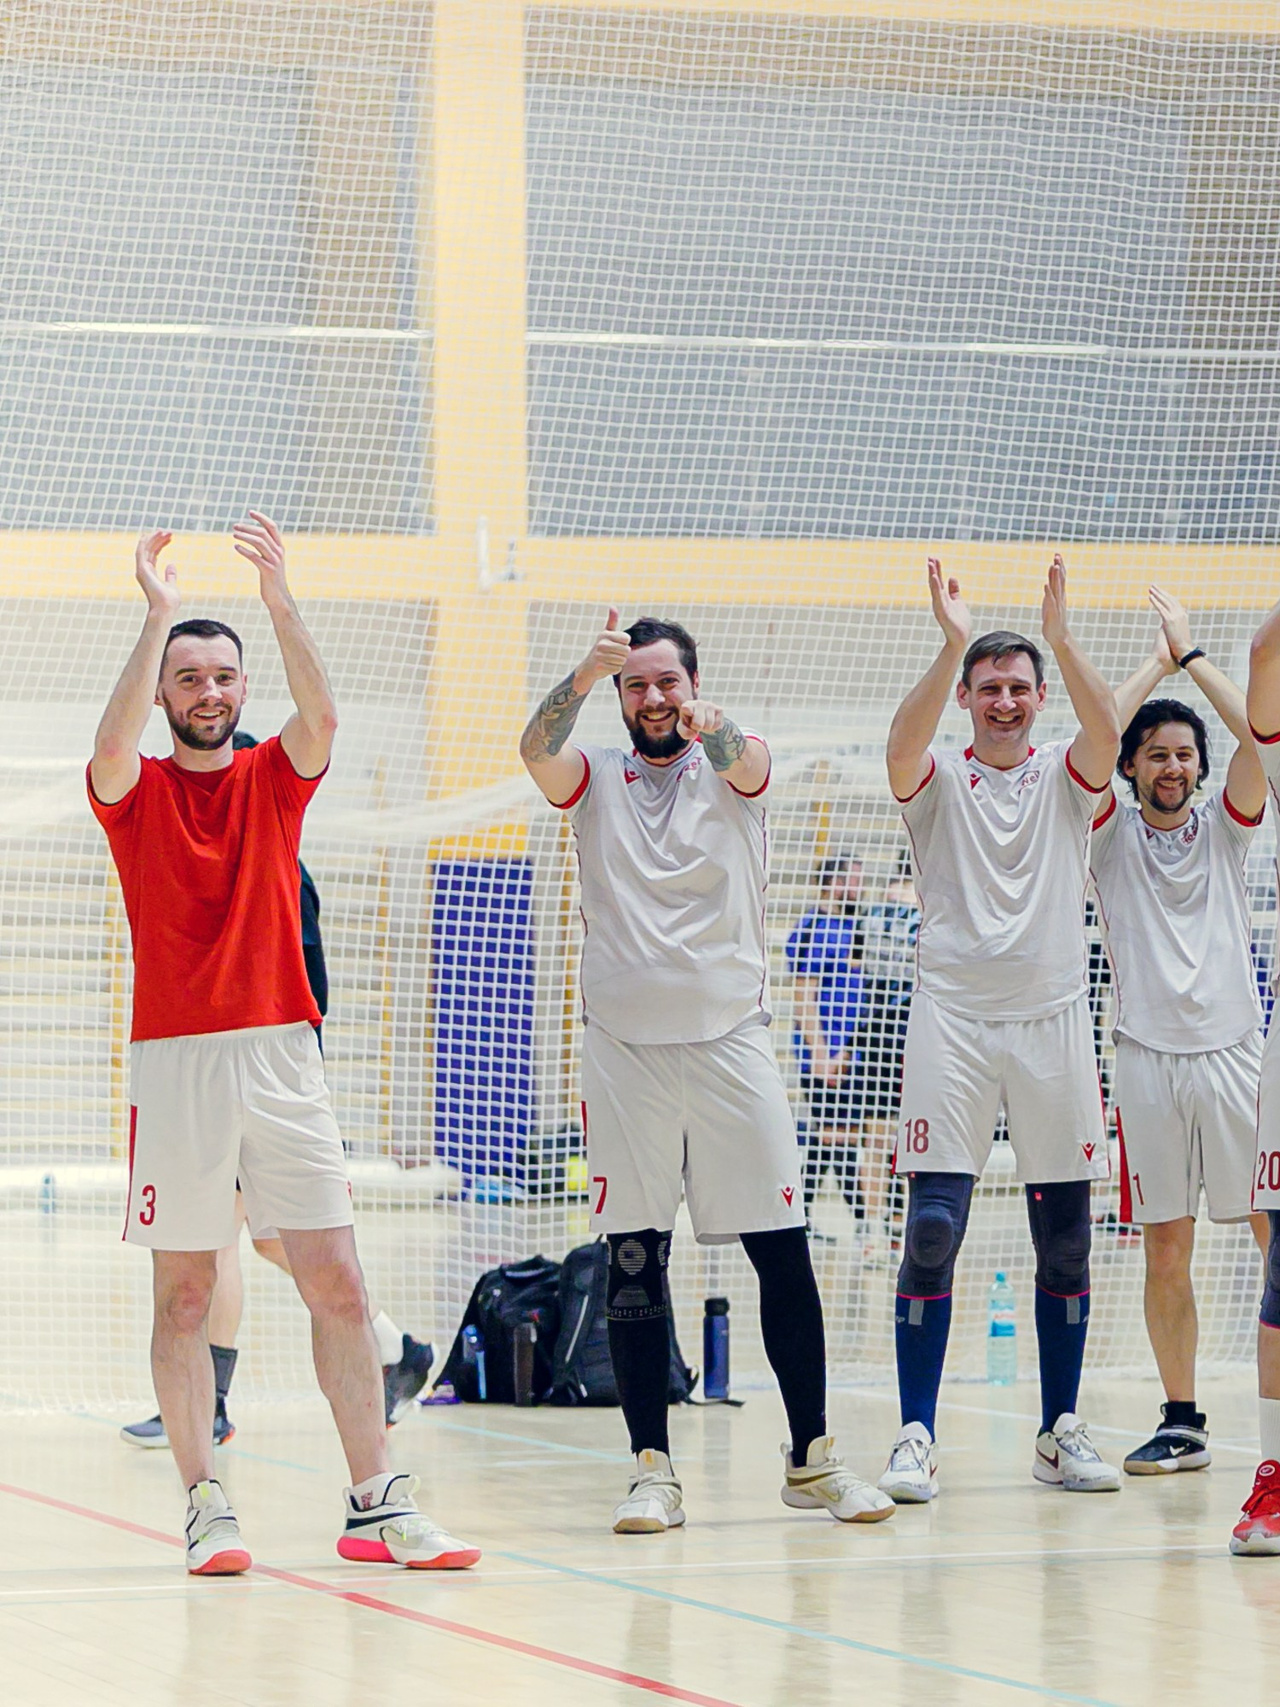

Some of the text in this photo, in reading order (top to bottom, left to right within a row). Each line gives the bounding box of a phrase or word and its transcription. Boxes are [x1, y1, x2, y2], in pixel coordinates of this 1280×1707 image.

[904, 1117, 929, 1154] 18
[138, 1183, 157, 1227] 3
[592, 1175, 608, 1215] 7
